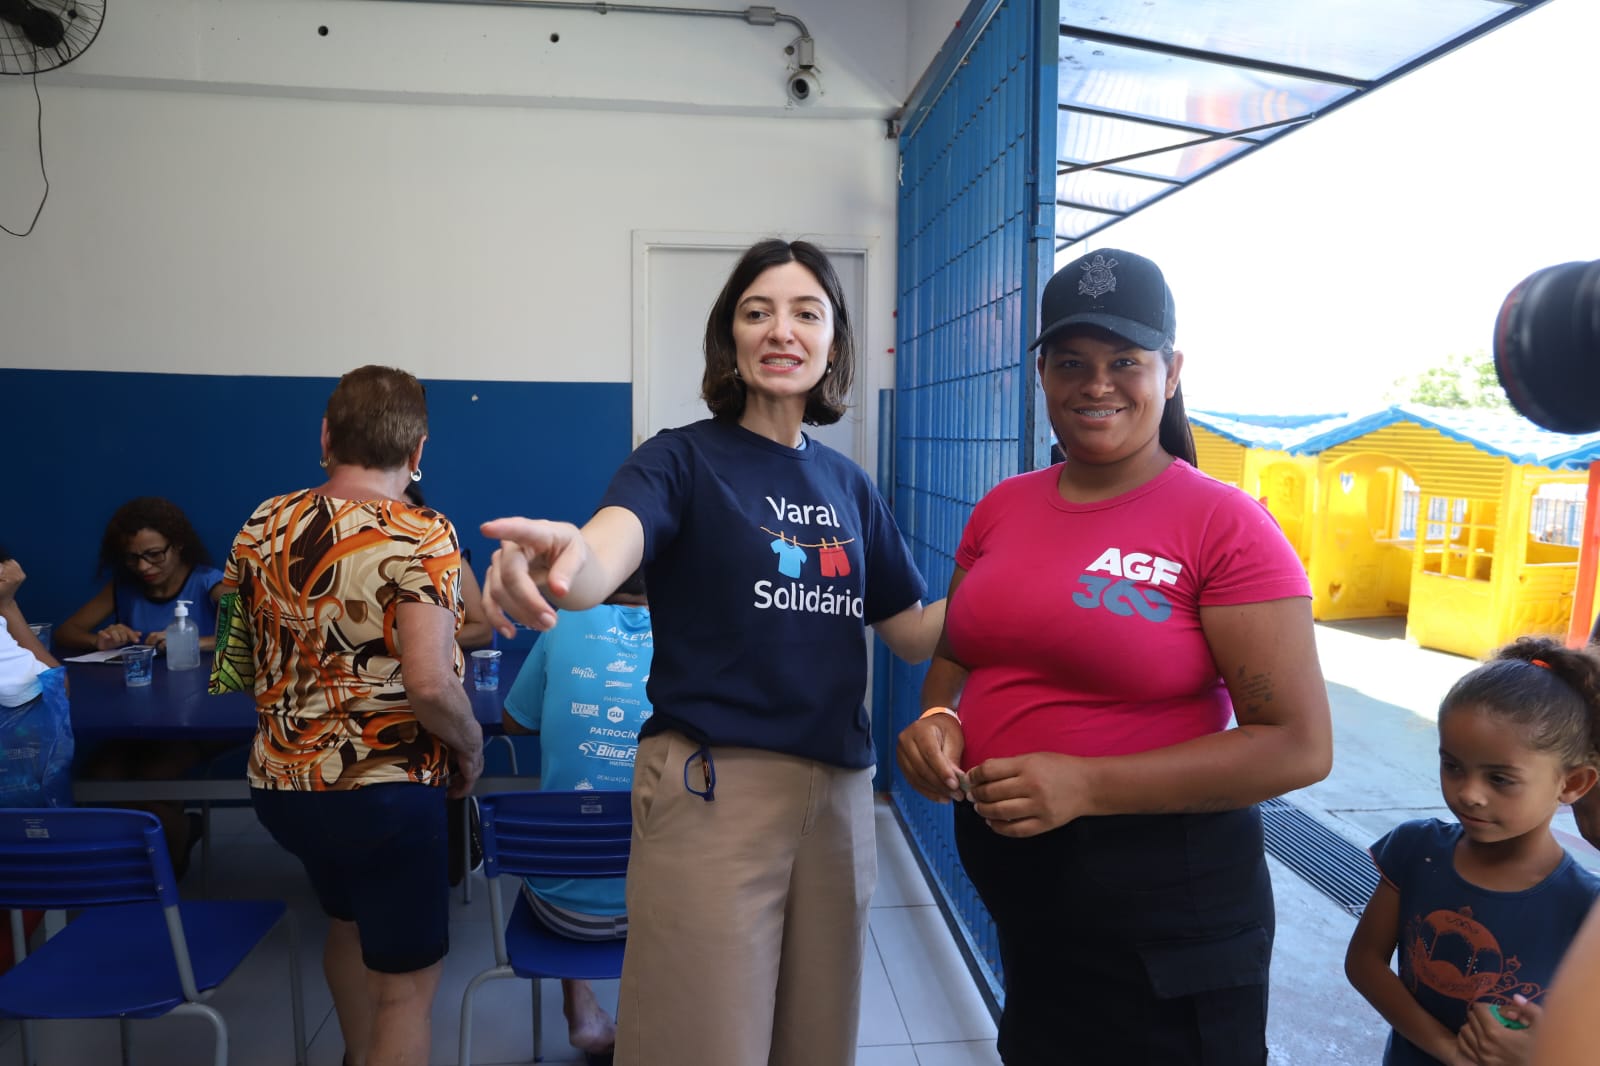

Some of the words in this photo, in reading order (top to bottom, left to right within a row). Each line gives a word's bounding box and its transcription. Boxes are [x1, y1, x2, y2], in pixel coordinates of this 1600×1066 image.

[765, 496, 840, 528] Varal
[1085, 547, 1183, 585] AGF
[754, 580, 864, 618] Solidário
[1072, 574, 1173, 623] 360
